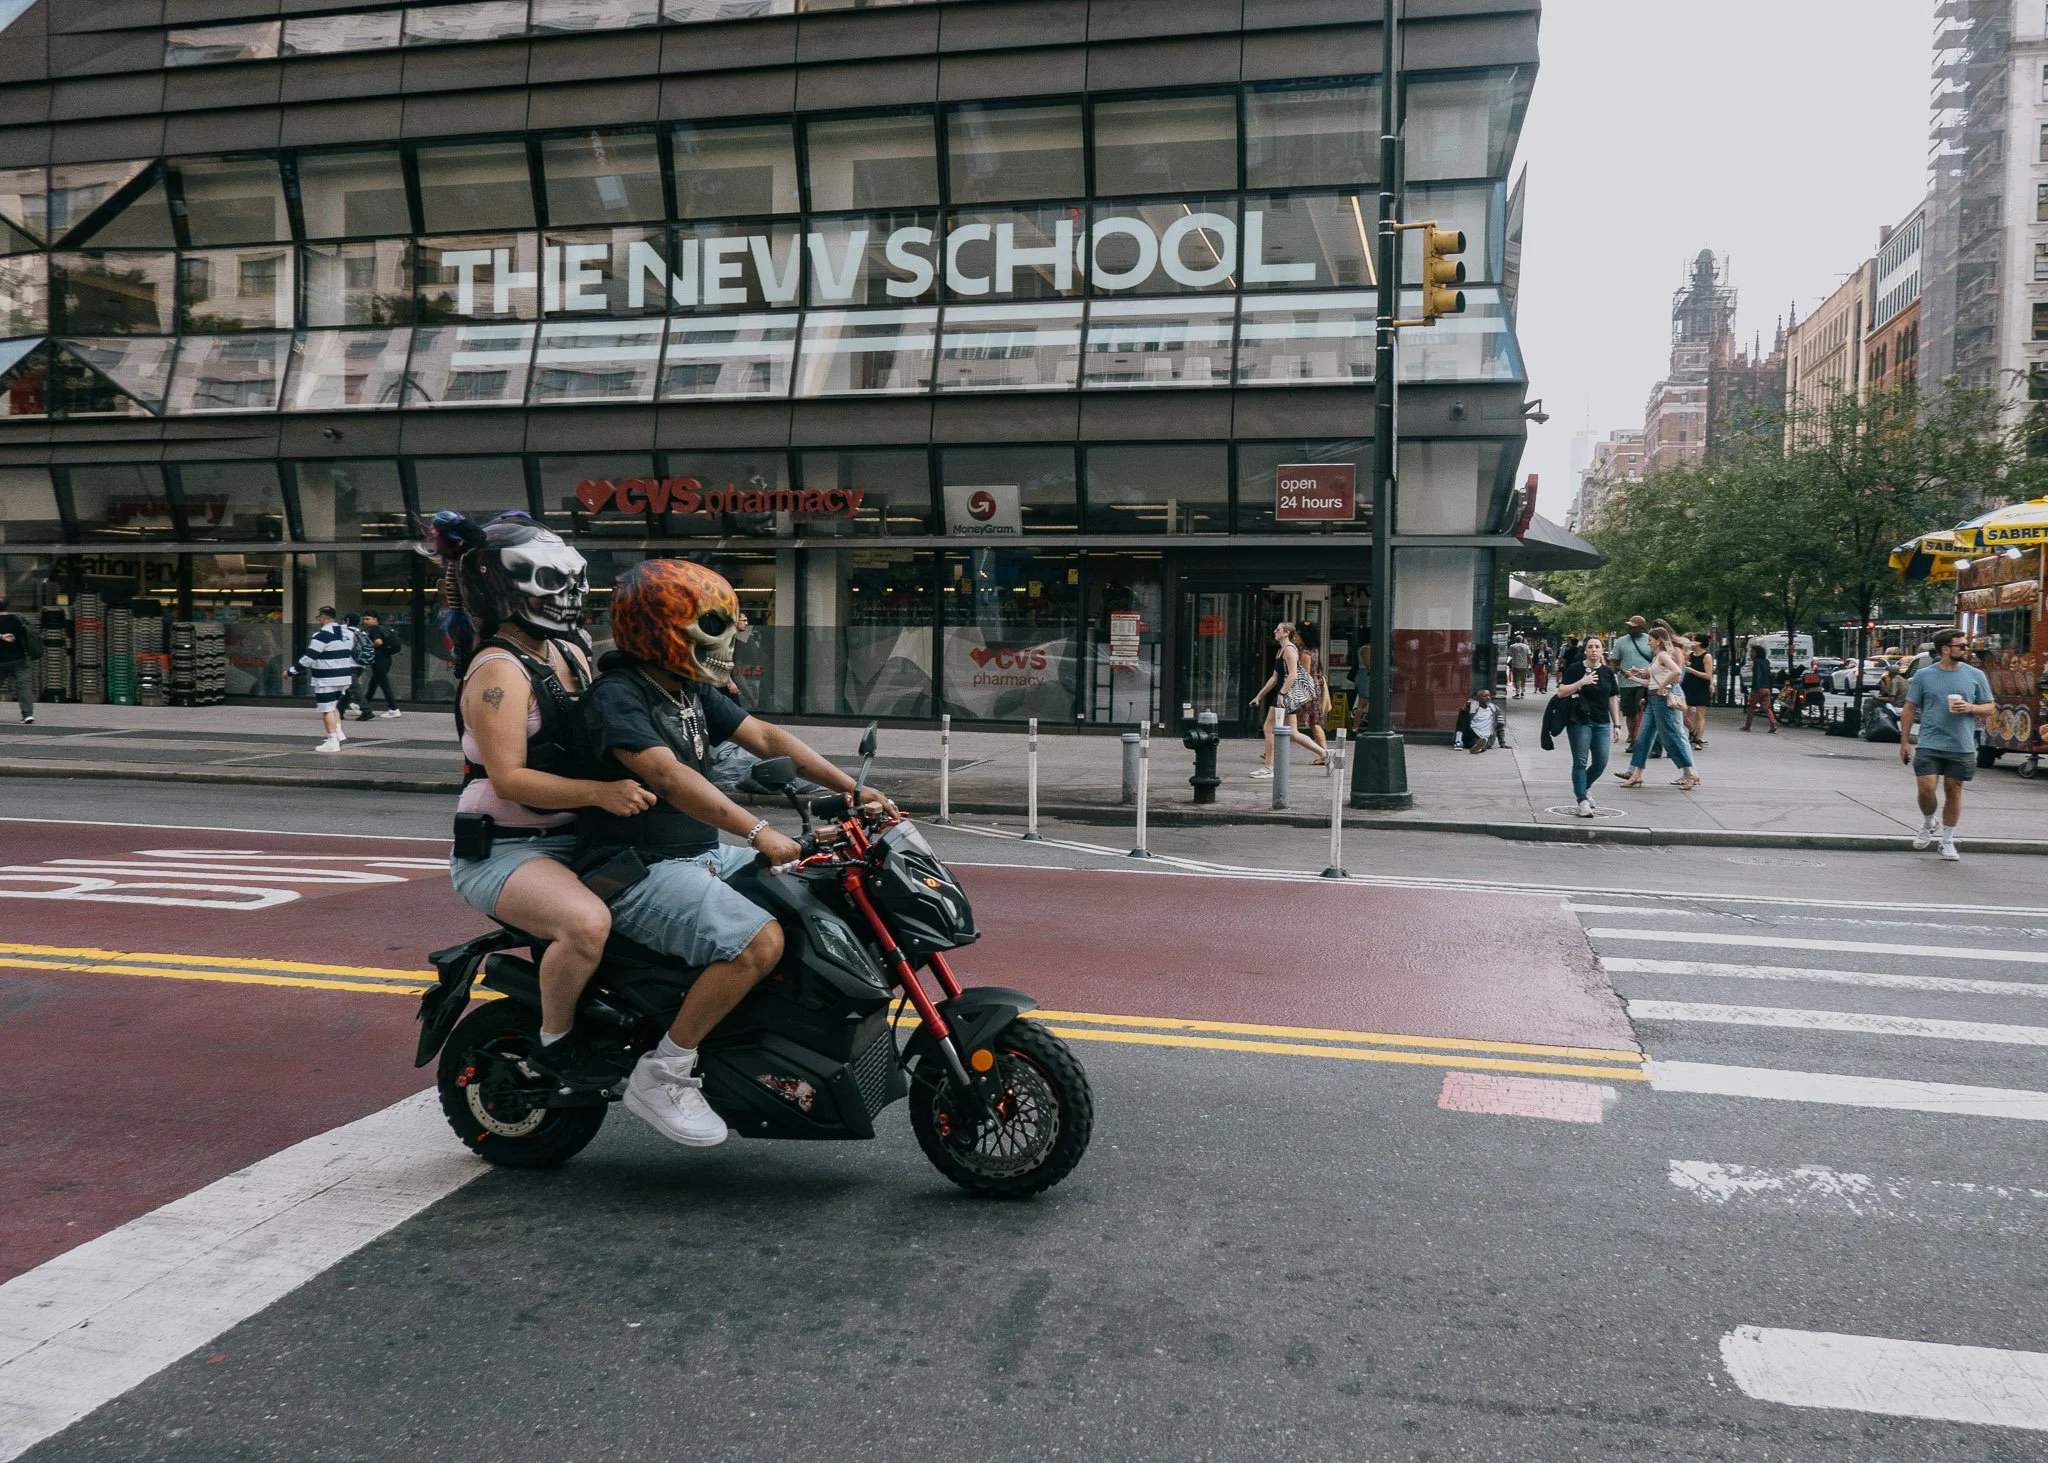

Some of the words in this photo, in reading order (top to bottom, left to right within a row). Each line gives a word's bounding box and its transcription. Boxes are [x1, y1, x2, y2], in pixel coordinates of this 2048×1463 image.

[441, 244, 608, 315] THE
[628, 230, 868, 308] NEW
[886, 210, 1316, 298] SCHOOL
[1280, 479, 1317, 493] open
[615, 477, 702, 514] CVS
[704, 482, 865, 520] pharmacy
[1280, 496, 1298, 509] 24
[1302, 495, 1343, 509] hours
[953, 523, 1014, 536] MoneyGram
[995, 647, 1047, 670] CVS
[973, 671, 1044, 689] pharmacy
